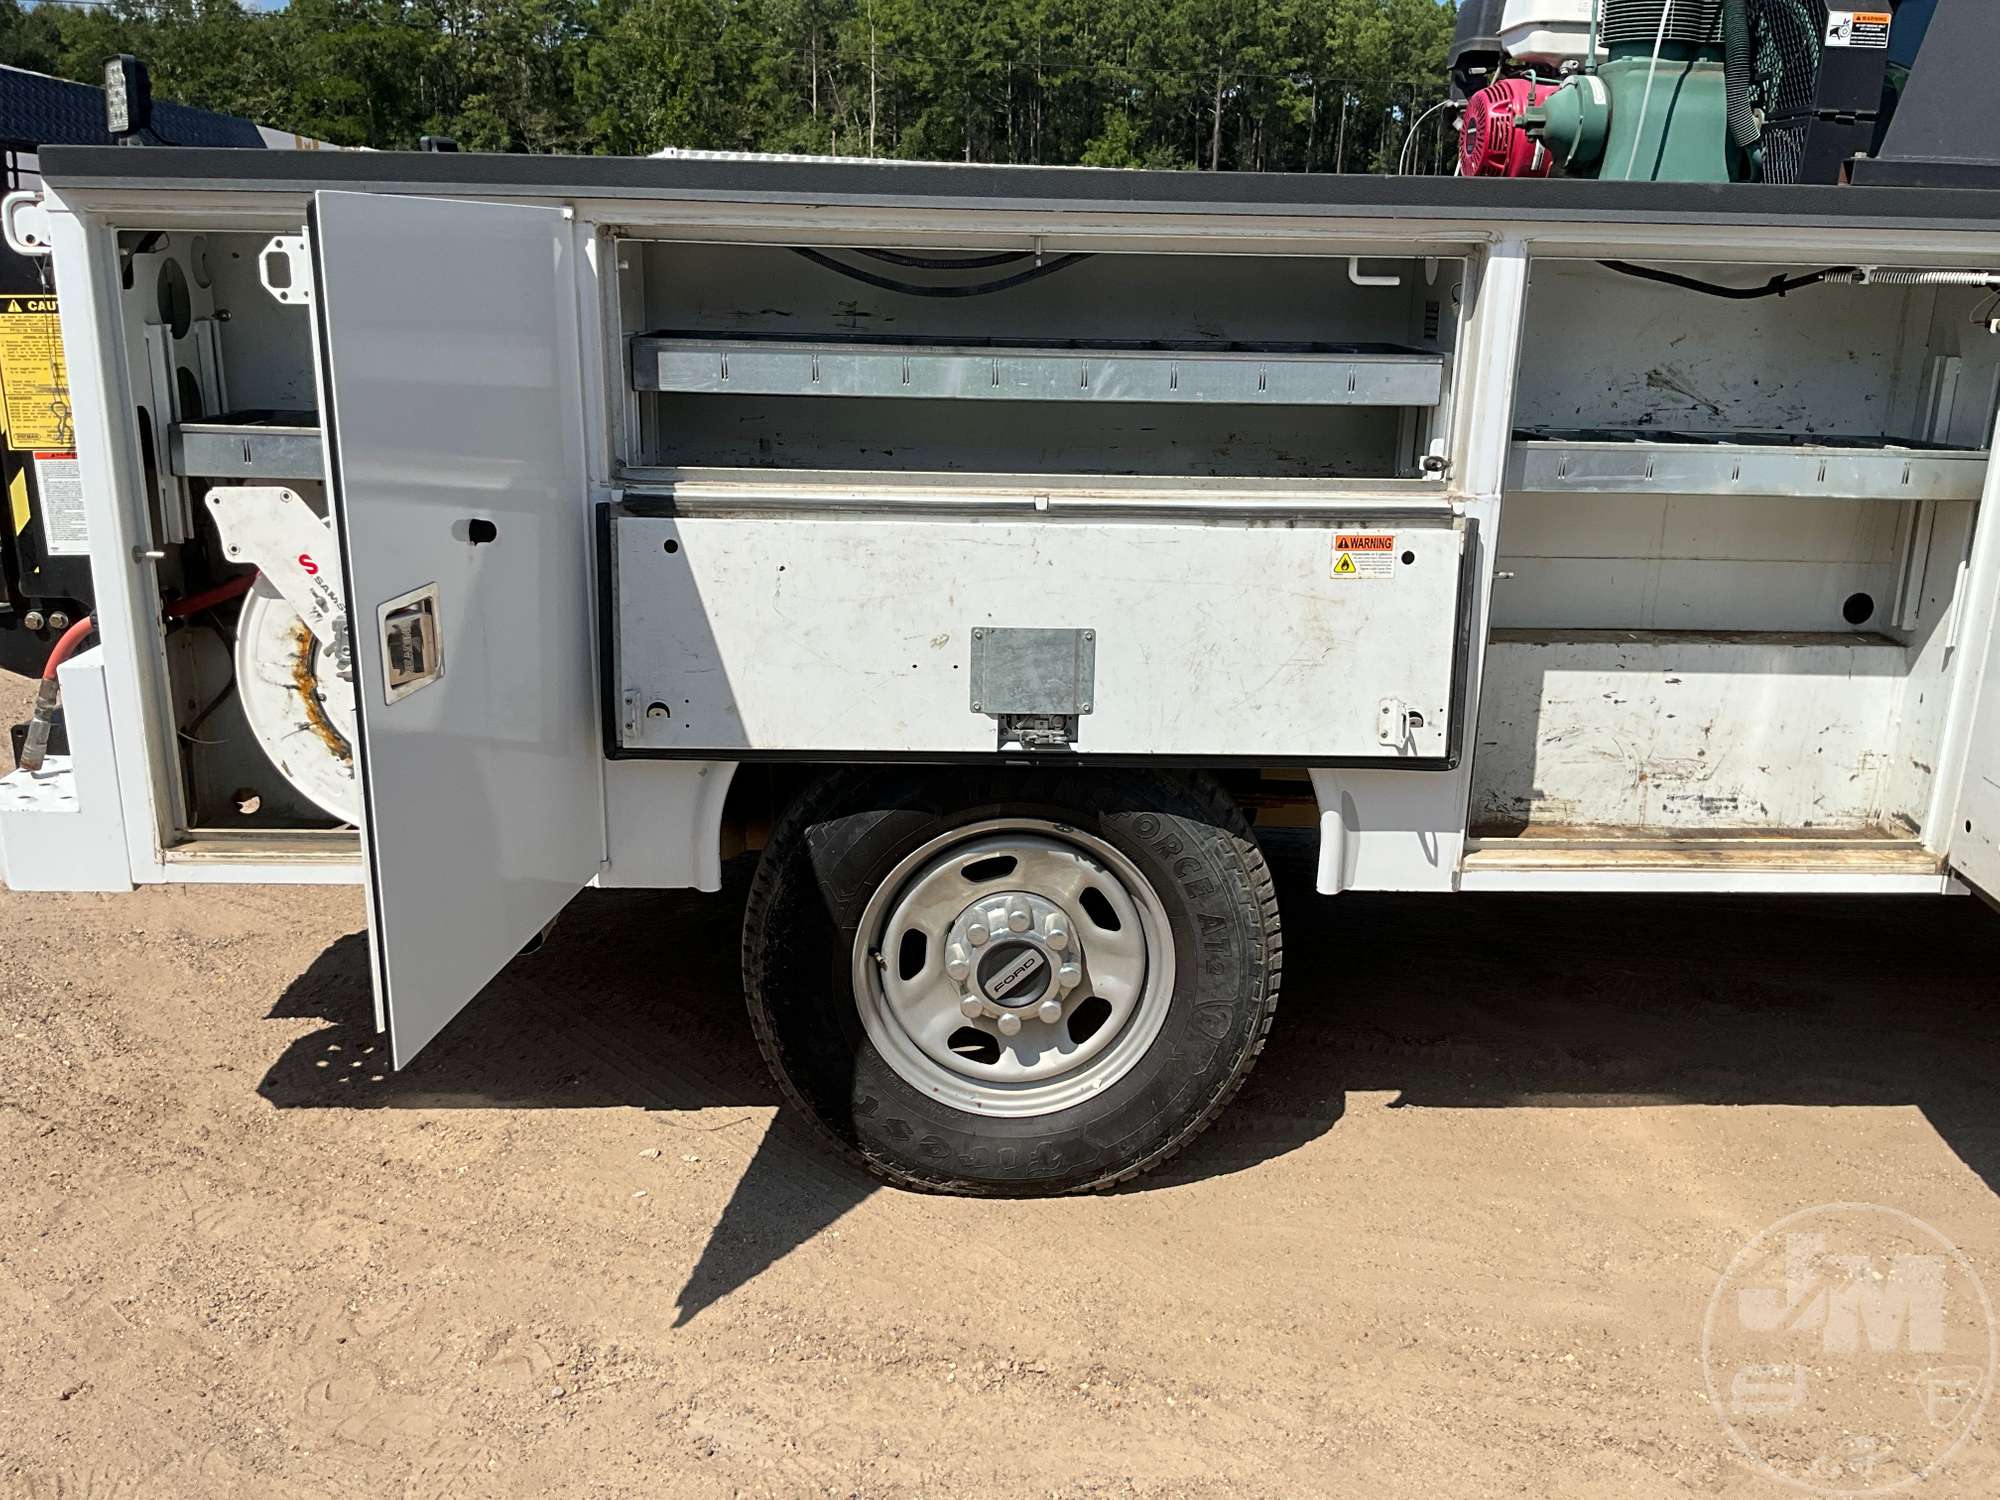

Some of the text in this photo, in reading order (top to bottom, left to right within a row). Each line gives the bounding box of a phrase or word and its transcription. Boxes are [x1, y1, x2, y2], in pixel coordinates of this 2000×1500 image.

[27, 300, 59, 311] CAU
[1350, 537, 1392, 549] WARNING
[314, 576, 347, 613] SAMS
[993, 958, 1036, 993] FORD
